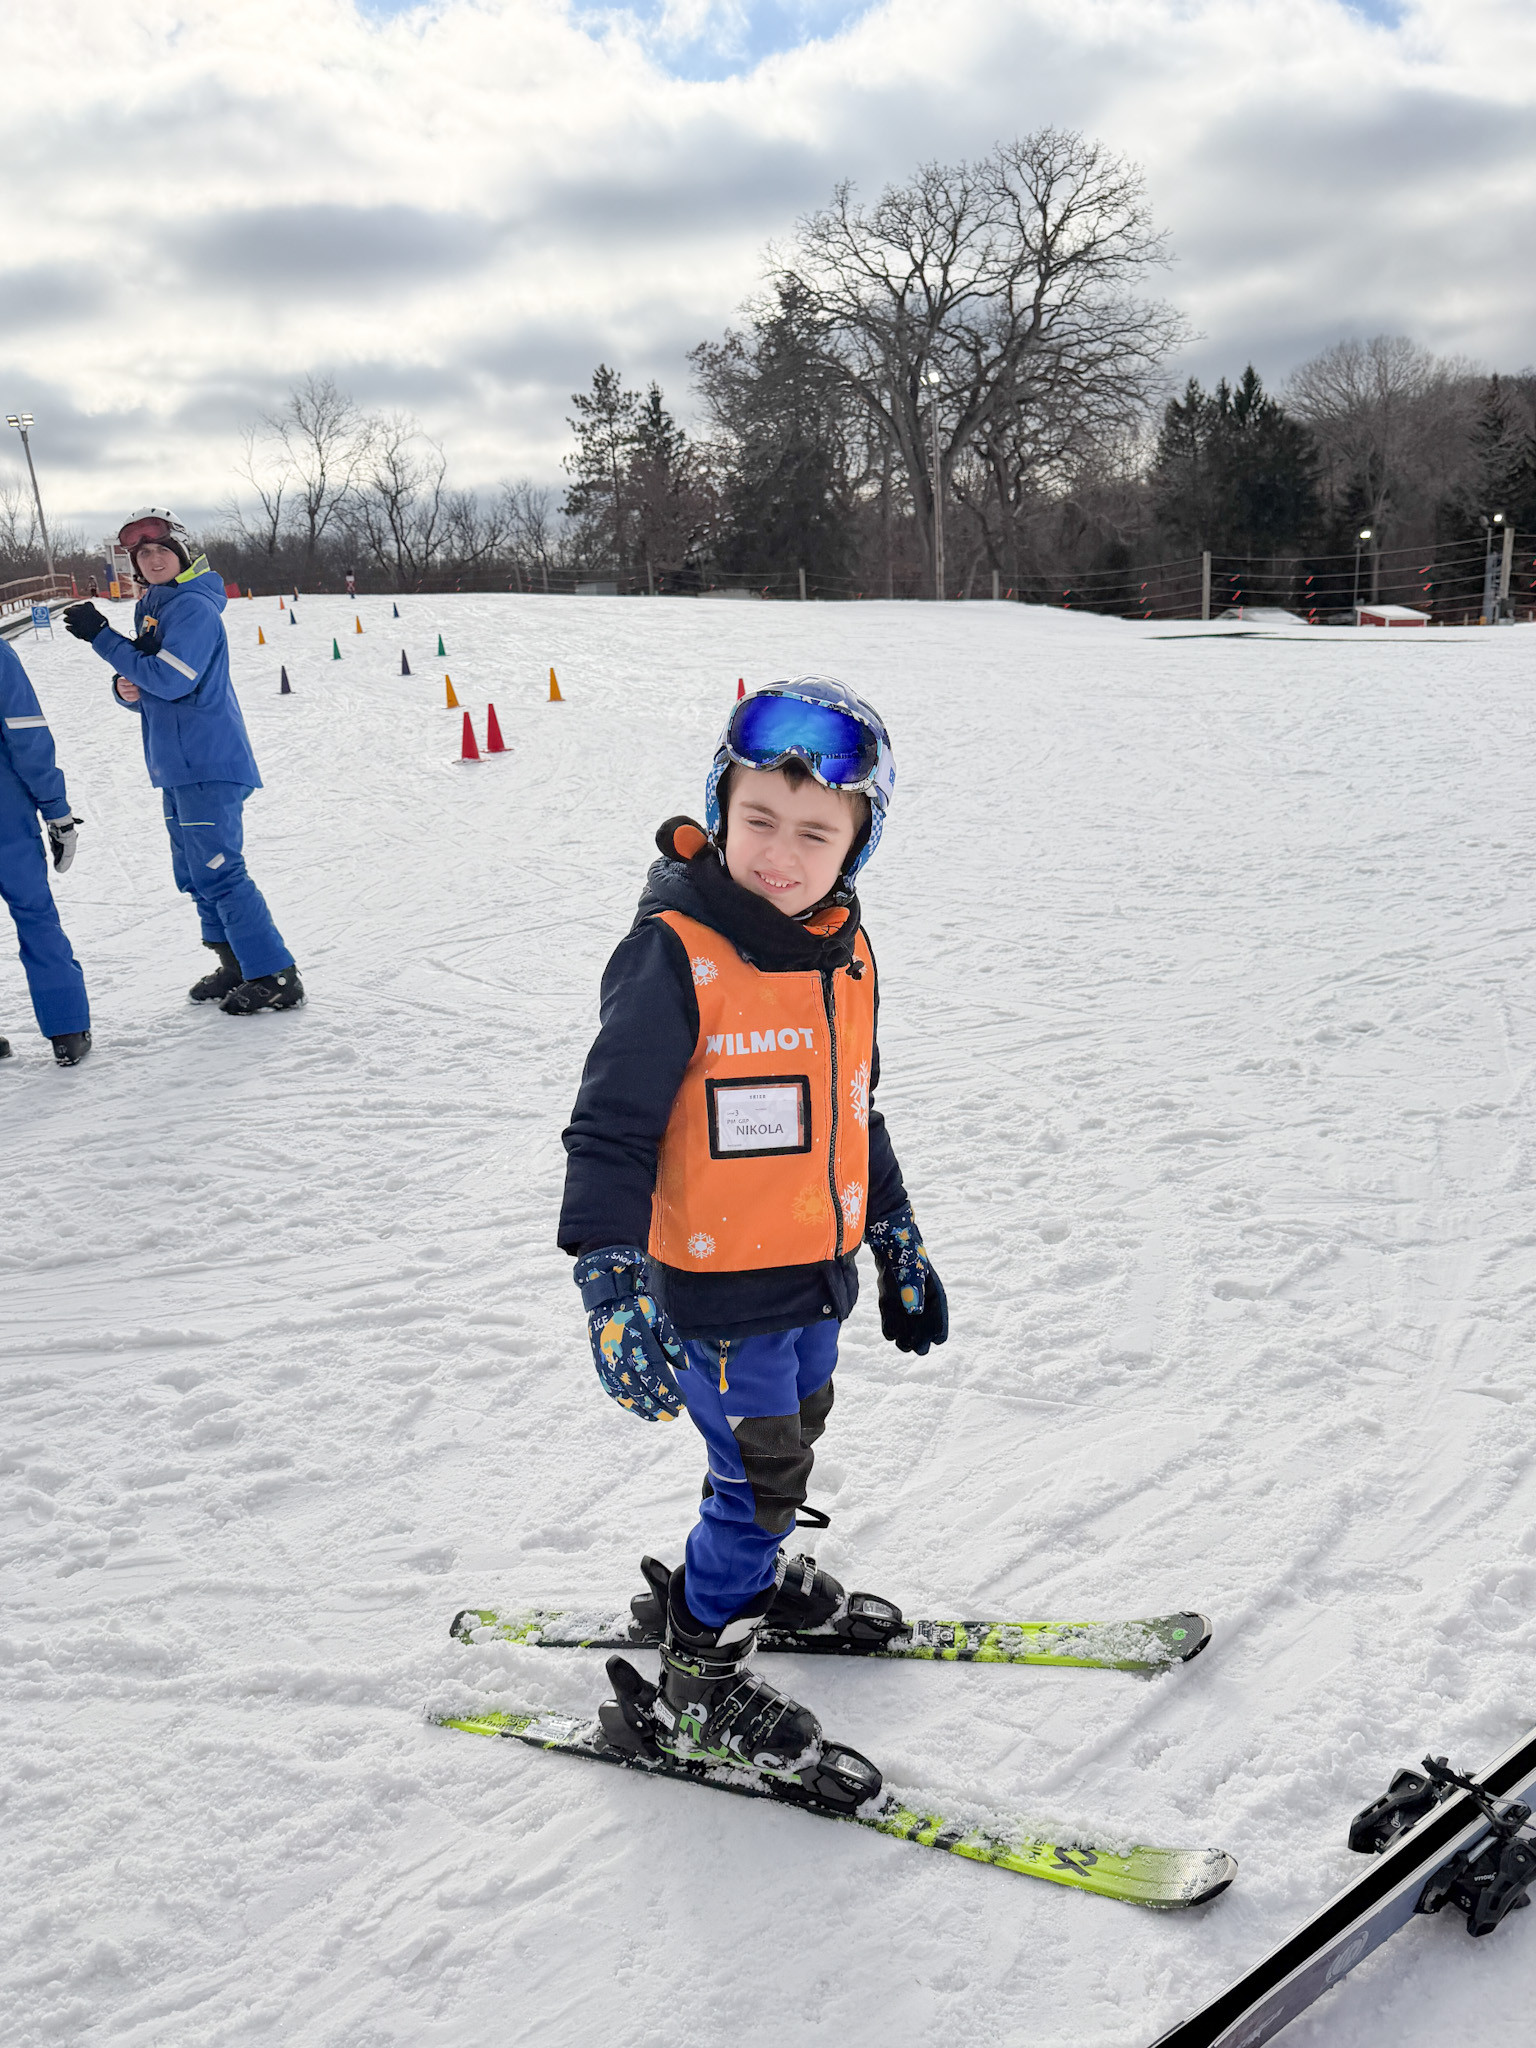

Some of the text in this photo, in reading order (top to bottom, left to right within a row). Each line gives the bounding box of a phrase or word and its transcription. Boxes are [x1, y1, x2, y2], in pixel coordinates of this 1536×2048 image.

[705, 1027, 814, 1056] WILMOT
[736, 1123, 784, 1136] NIKOLA
[610, 1251, 634, 1267] SNOW
[898, 1248, 910, 1265] ICE
[593, 1315, 608, 1331] ICE
